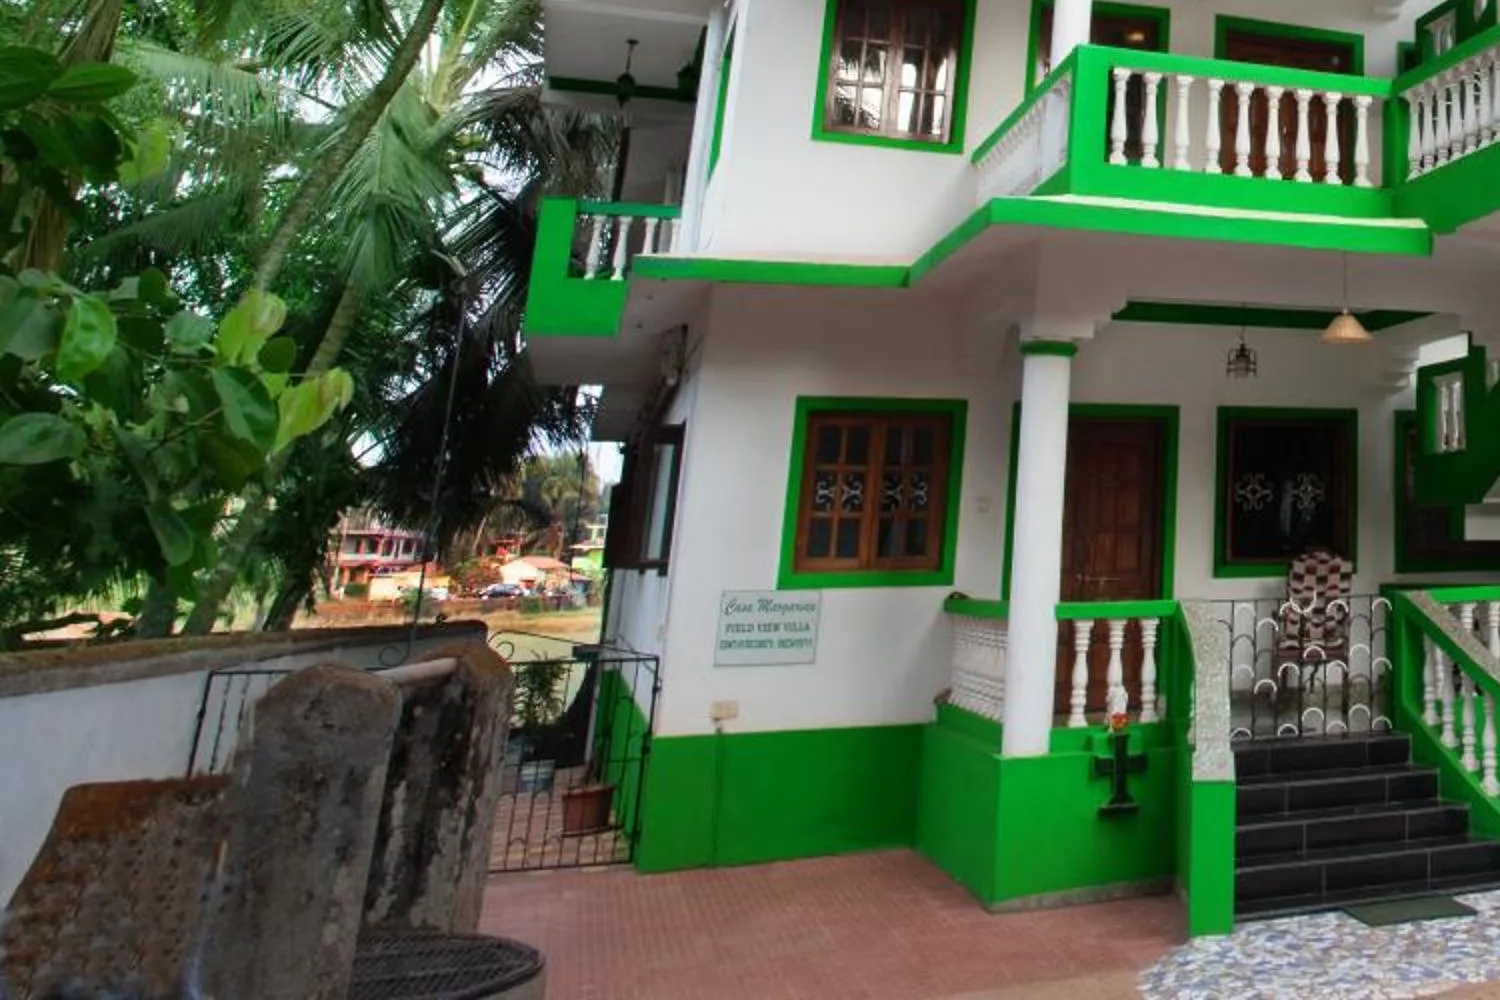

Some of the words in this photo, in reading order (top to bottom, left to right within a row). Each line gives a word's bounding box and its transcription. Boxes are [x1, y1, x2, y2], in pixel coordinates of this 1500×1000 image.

[726, 623, 755, 634] FIELD
[757, 622, 781, 633] VIEW
[783, 621, 811, 633] VILLA
